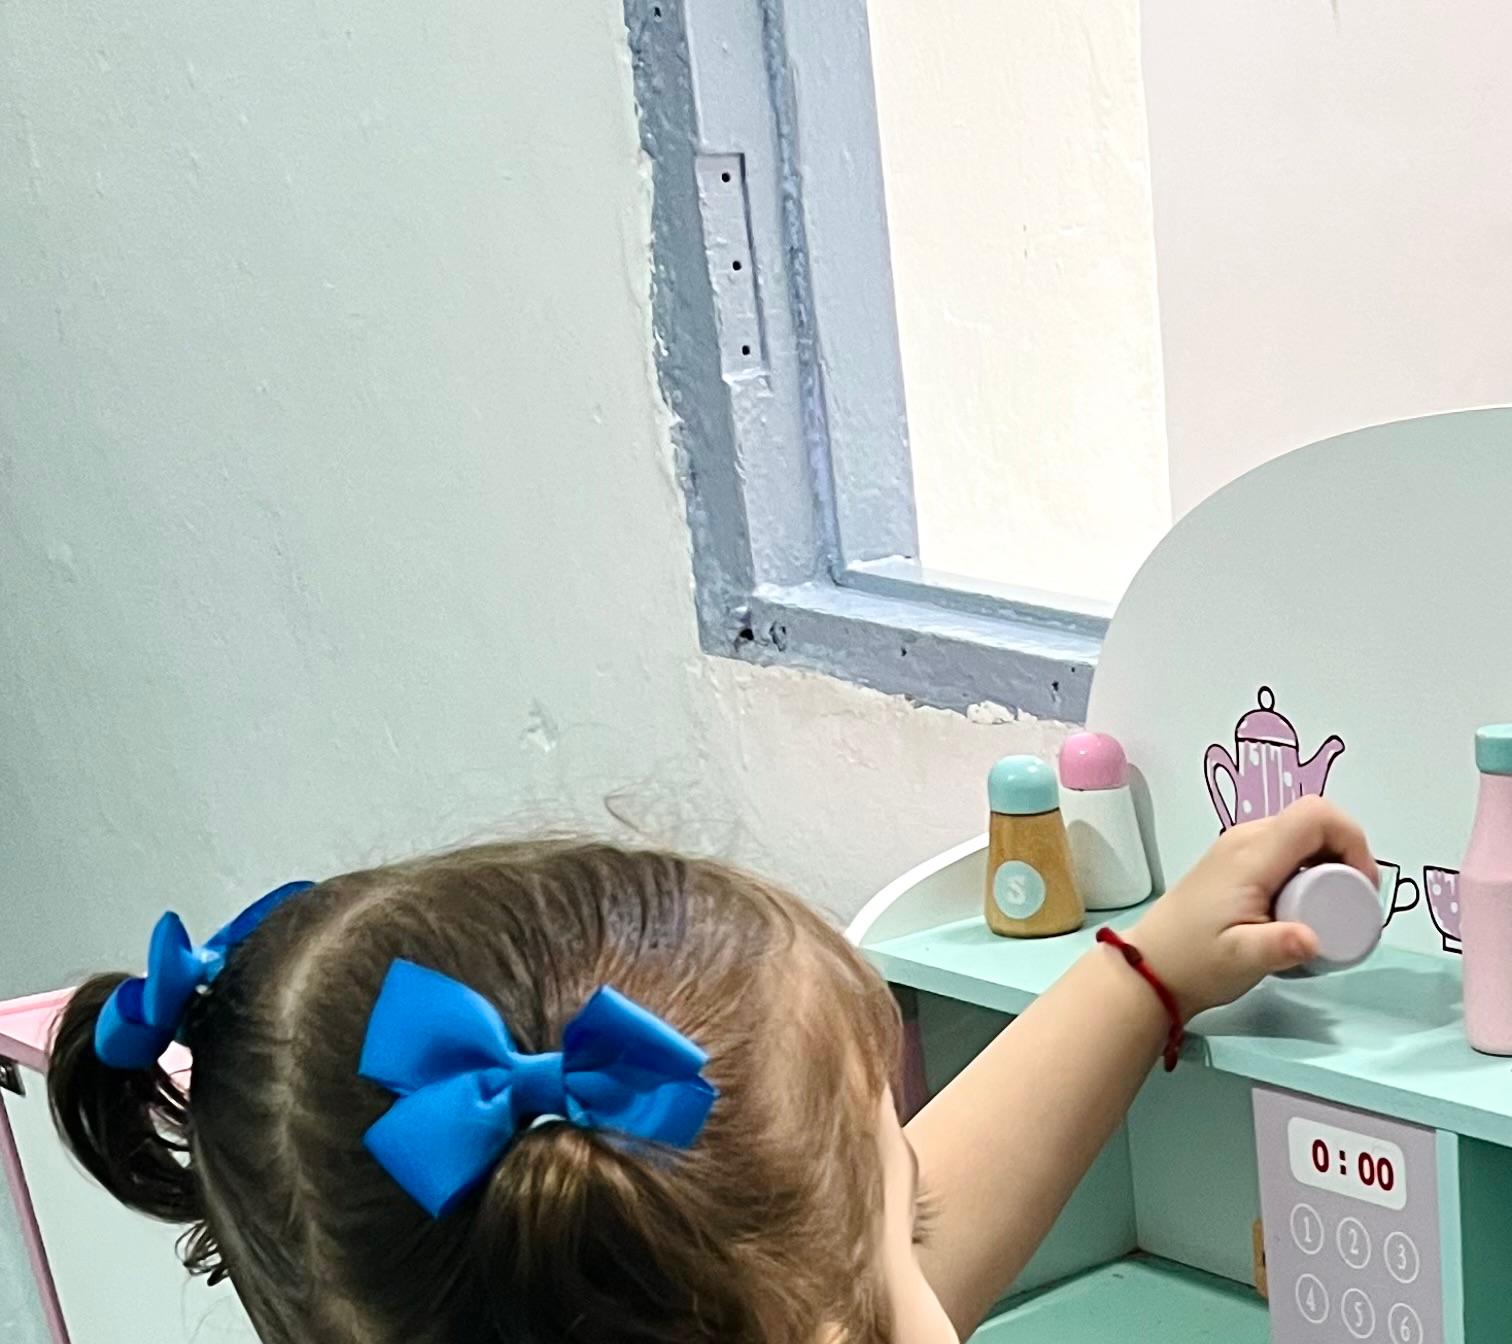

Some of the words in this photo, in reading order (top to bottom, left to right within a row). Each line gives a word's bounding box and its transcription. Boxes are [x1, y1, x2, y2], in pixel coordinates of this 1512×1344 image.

[1006, 874, 1027, 906] S
[1302, 1215, 1313, 1244] 1
[1348, 1228, 1360, 1255] 2
[1396, 1243, 1408, 1271] 3
[1305, 1286, 1318, 1312] 4
[1353, 1302, 1364, 1328] 5
[1400, 1314, 1412, 1343] 6
